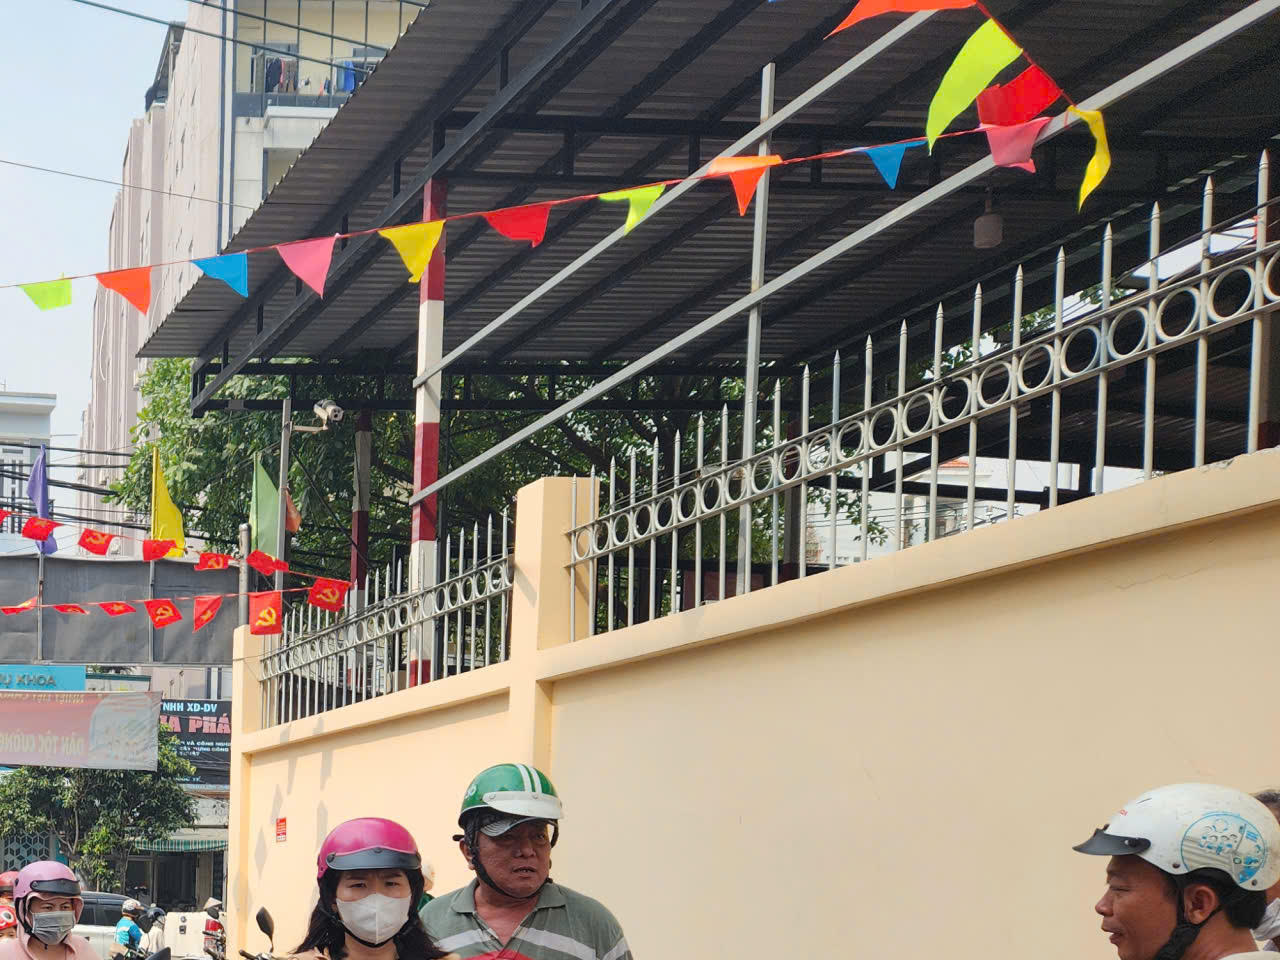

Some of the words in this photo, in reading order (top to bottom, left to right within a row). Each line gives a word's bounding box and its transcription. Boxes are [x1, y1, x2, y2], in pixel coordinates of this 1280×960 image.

[16, 673, 57, 687] KHOA
[160, 702, 184, 712] NHH
[187, 703, 218, 713] XD-DV
[188, 712, 232, 734] PHÁ
